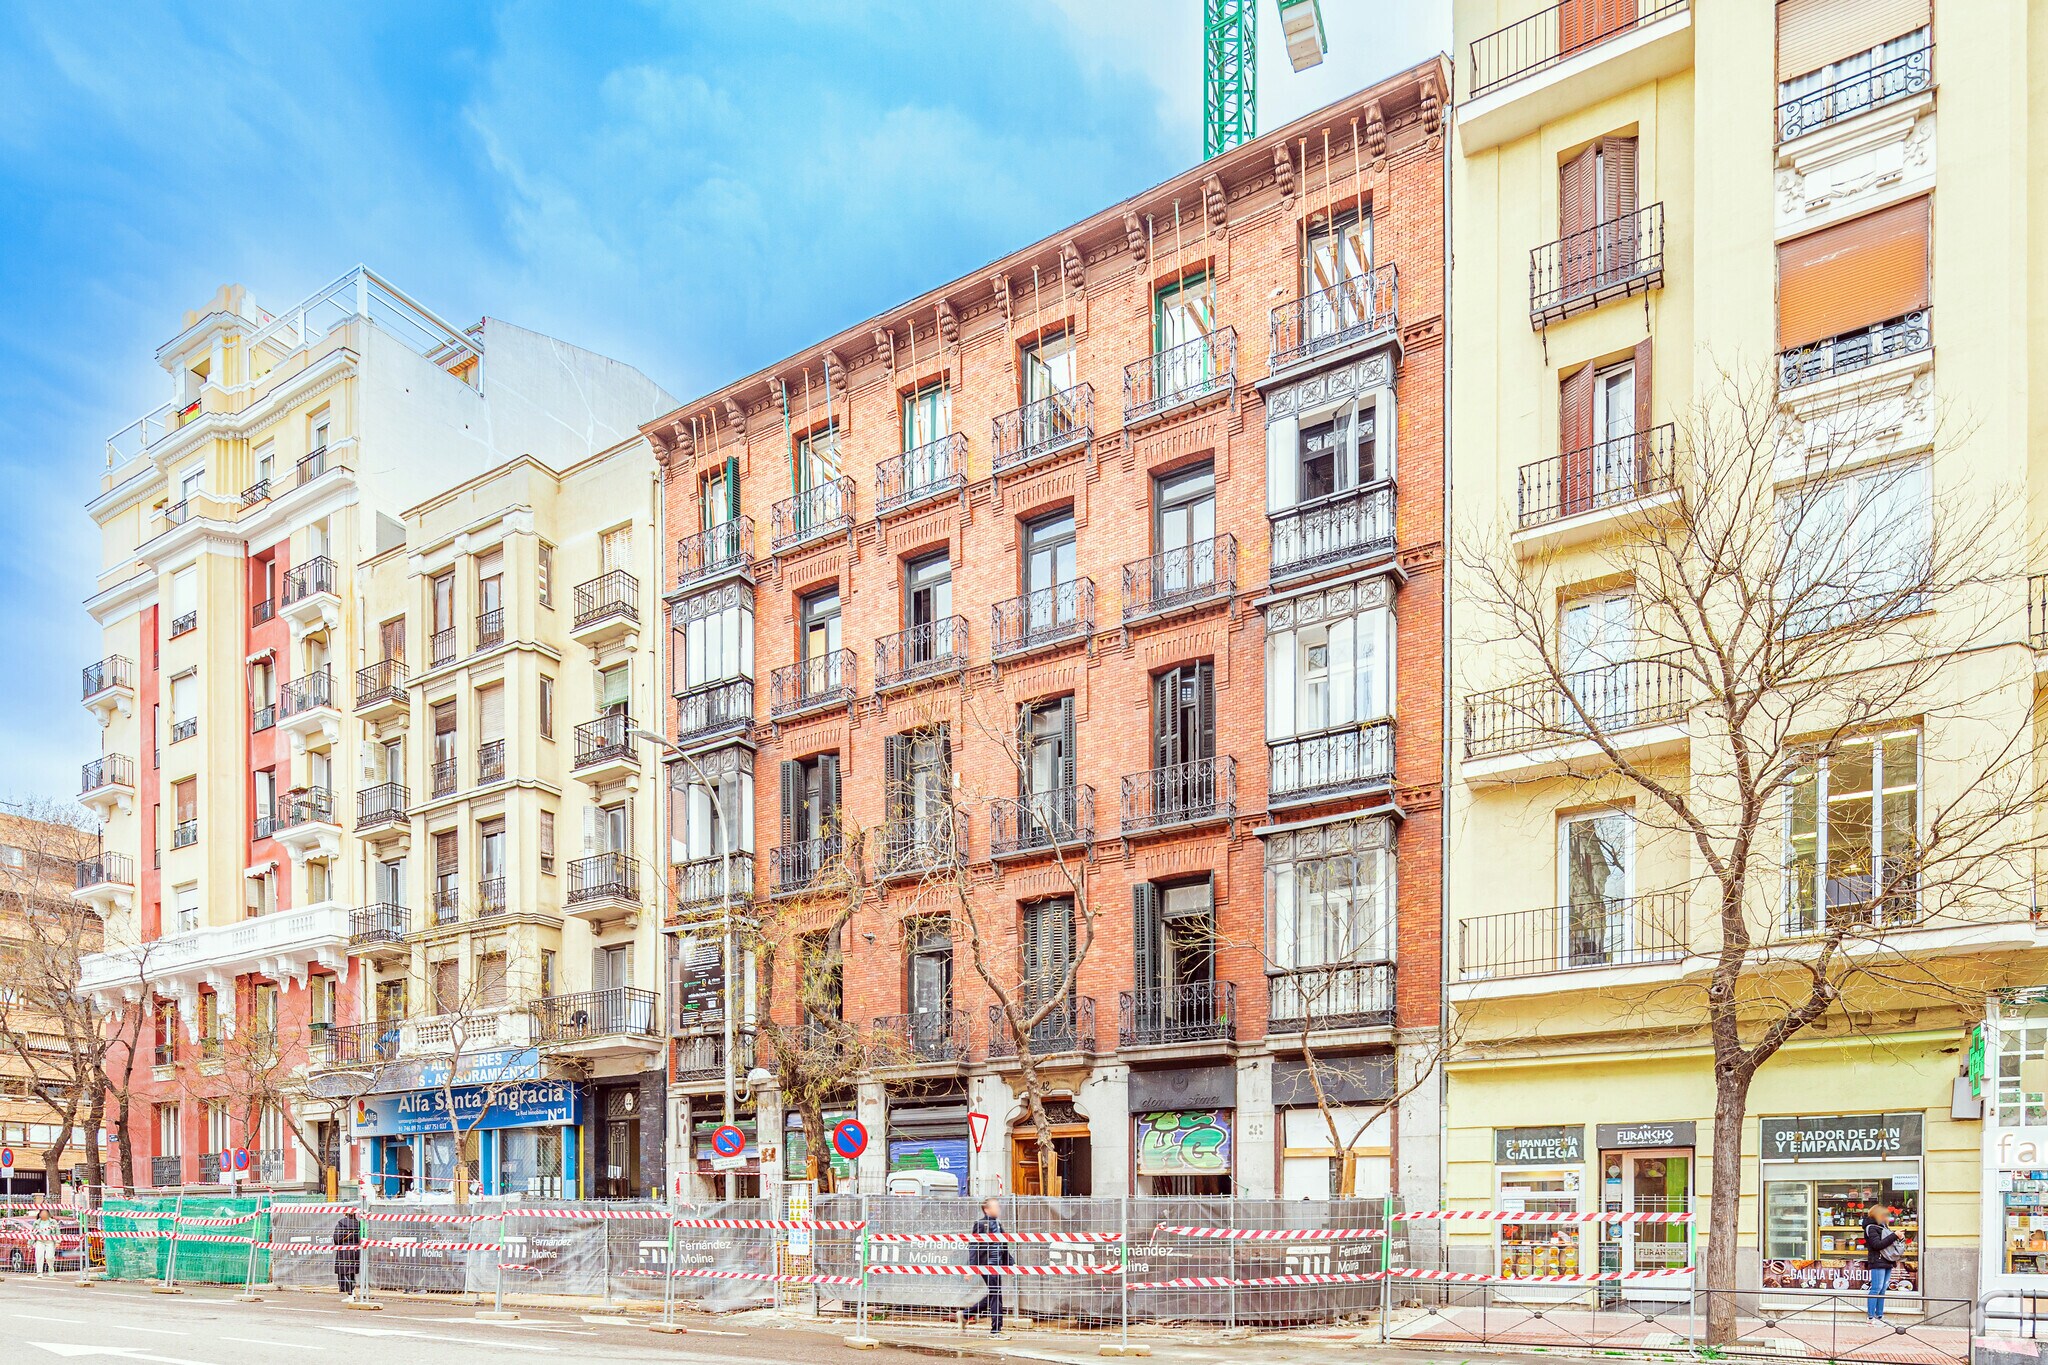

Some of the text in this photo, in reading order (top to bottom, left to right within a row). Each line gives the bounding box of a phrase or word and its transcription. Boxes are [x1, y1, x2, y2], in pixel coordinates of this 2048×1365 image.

[1041, 1080, 1050, 1091] 42
[397, 1094, 430, 1113] Alfa
[435, 1091, 482, 1110] Snta
[366, 1113, 377, 1121] Alfa
[1617, 1129, 1674, 1141] FURANCHO
[1848, 1129, 1867, 1140] DE
[1505, 1136, 1578, 1148] EPANADEÍA
[1775, 1138, 1901, 1153] Y EMPANADAS
[1505, 1146, 1578, 1160] GALLEGA
[531, 1236, 571, 1246] Fernández
[679, 1240, 731, 1251] Fernández
[531, 1249, 558, 1259] Molina
[1106, 1244, 1174, 1257] Fenández
[1338, 1244, 1372, 1258] Fernández
[680, 1254, 714, 1264] Molina
[909, 1252, 948, 1264] Molina
[1106, 1260, 1149, 1272] Mlina
[1338, 1261, 1359, 1273] Molina
[1790, 1268, 1826, 1280] GALICIA
[1828, 1268, 1841, 1280] EN
